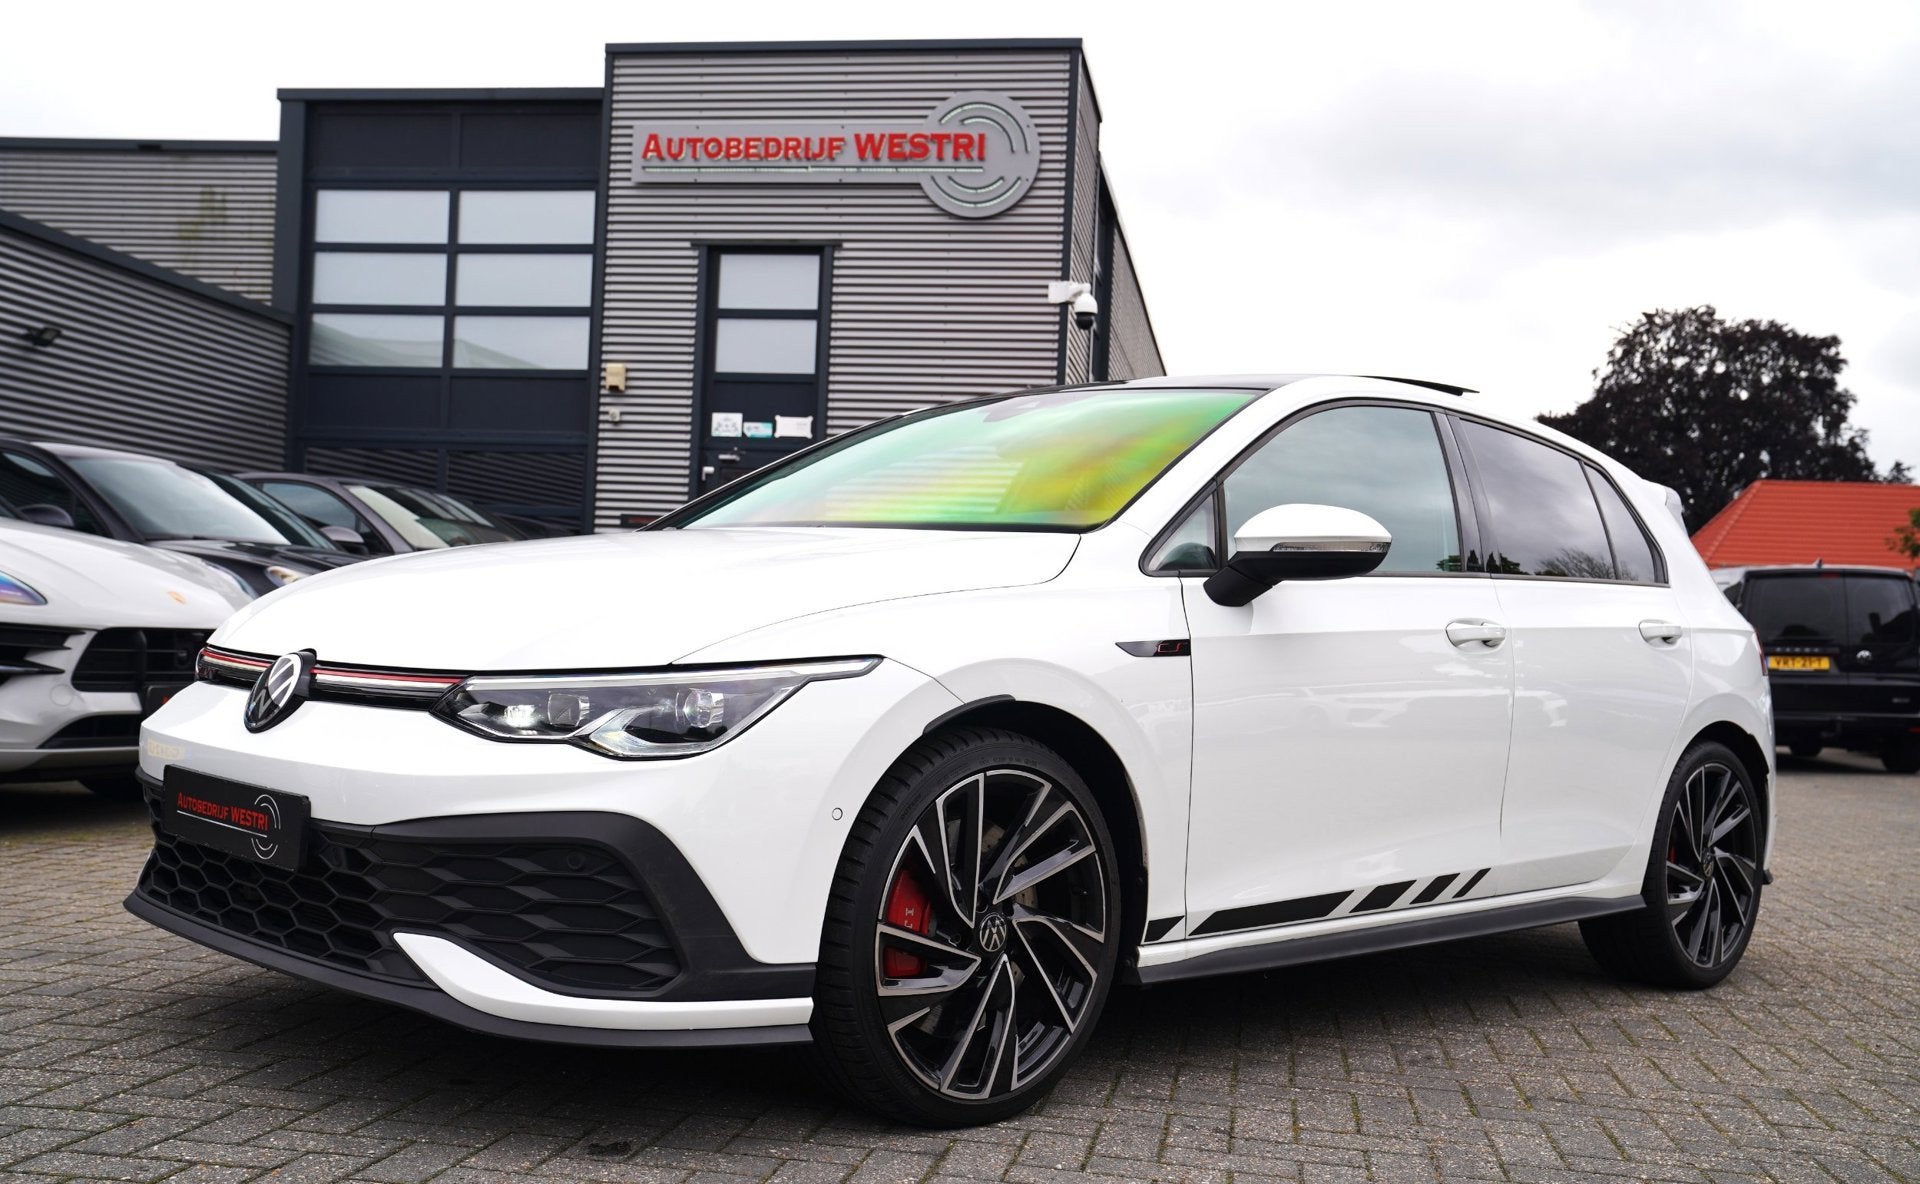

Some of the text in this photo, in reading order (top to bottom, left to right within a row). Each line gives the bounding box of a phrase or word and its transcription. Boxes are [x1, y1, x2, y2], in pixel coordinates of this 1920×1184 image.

[641, 133, 986, 161] AUTOBEDRIJF WESTRI
[177, 793, 268, 830] AUTOBEDRIJF WESTRI
